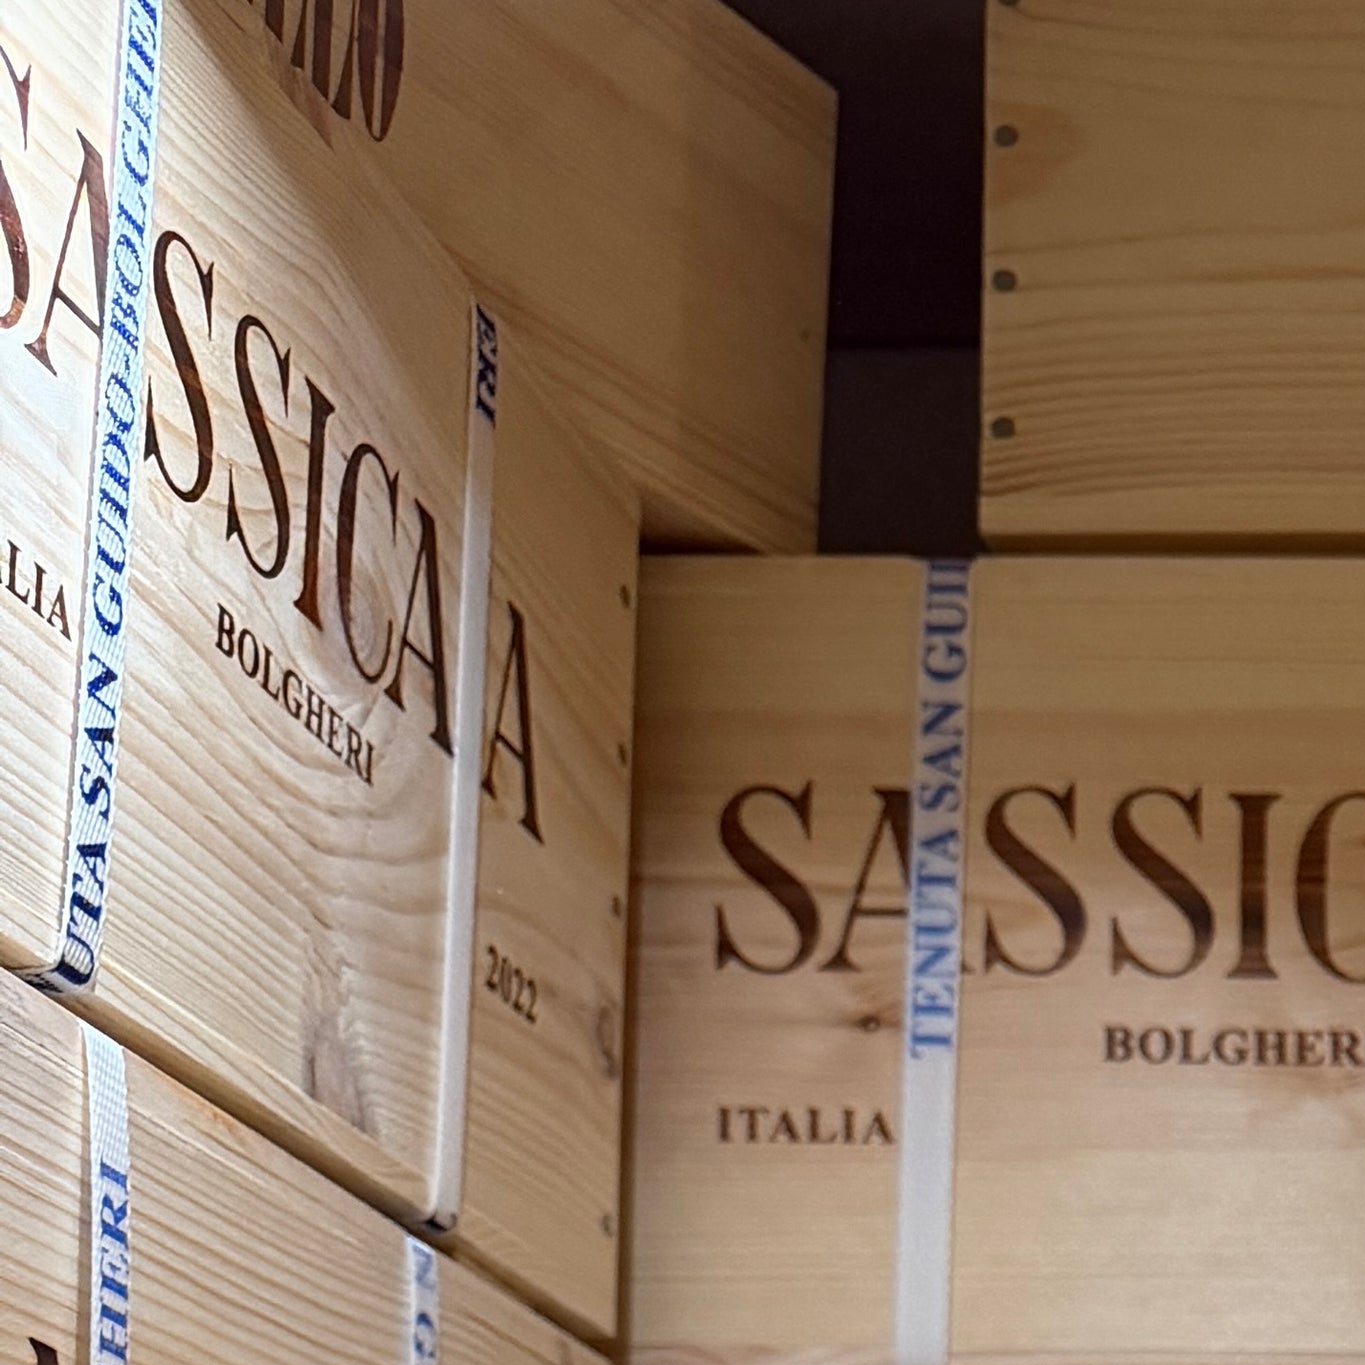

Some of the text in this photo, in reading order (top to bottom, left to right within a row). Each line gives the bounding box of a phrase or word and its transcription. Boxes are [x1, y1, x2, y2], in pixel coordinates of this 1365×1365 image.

[0, 538, 72, 642] LIA
[78, 650, 121, 817] SAN
[214, 603, 376, 786] BOLGHERI
[917, 700, 963, 814] SAN
[487, 945, 538, 1023] 2022
[909, 829, 960, 1061] TENUTA
[716, 1106, 895, 1145] ITALIA
